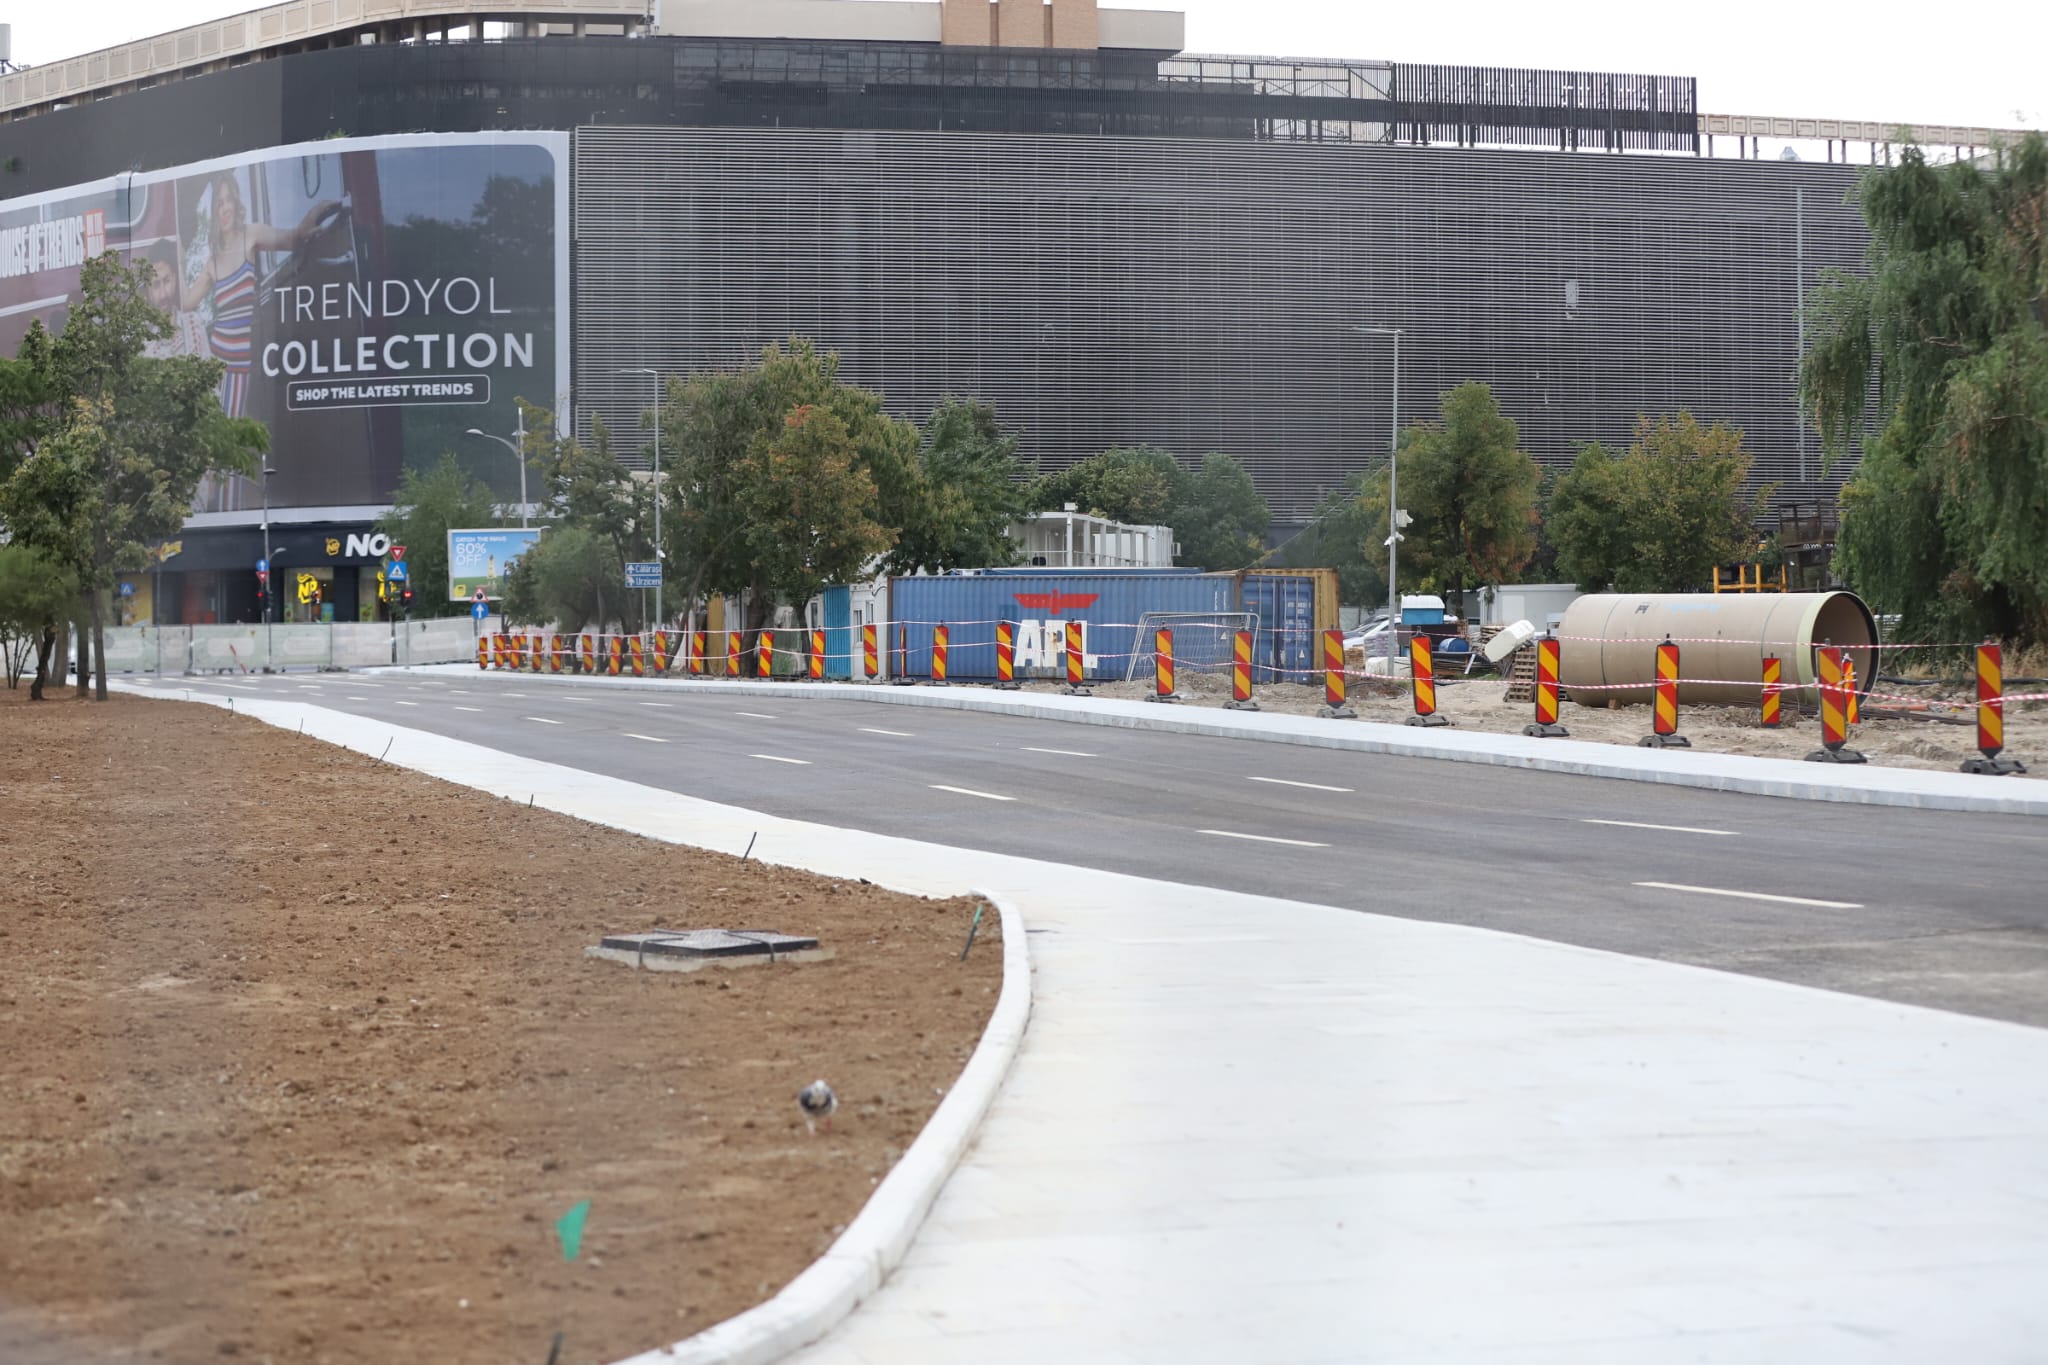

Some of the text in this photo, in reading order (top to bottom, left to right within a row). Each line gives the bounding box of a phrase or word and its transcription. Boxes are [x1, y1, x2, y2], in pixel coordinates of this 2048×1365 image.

[274, 277, 511, 324] TRENDYOL
[262, 333, 533, 377] COLLECTION
[296, 383, 474, 401] SHOP THE LATEST TRENDS
[456, 542, 486, 554] 60%
[456, 554, 481, 567] OFF
